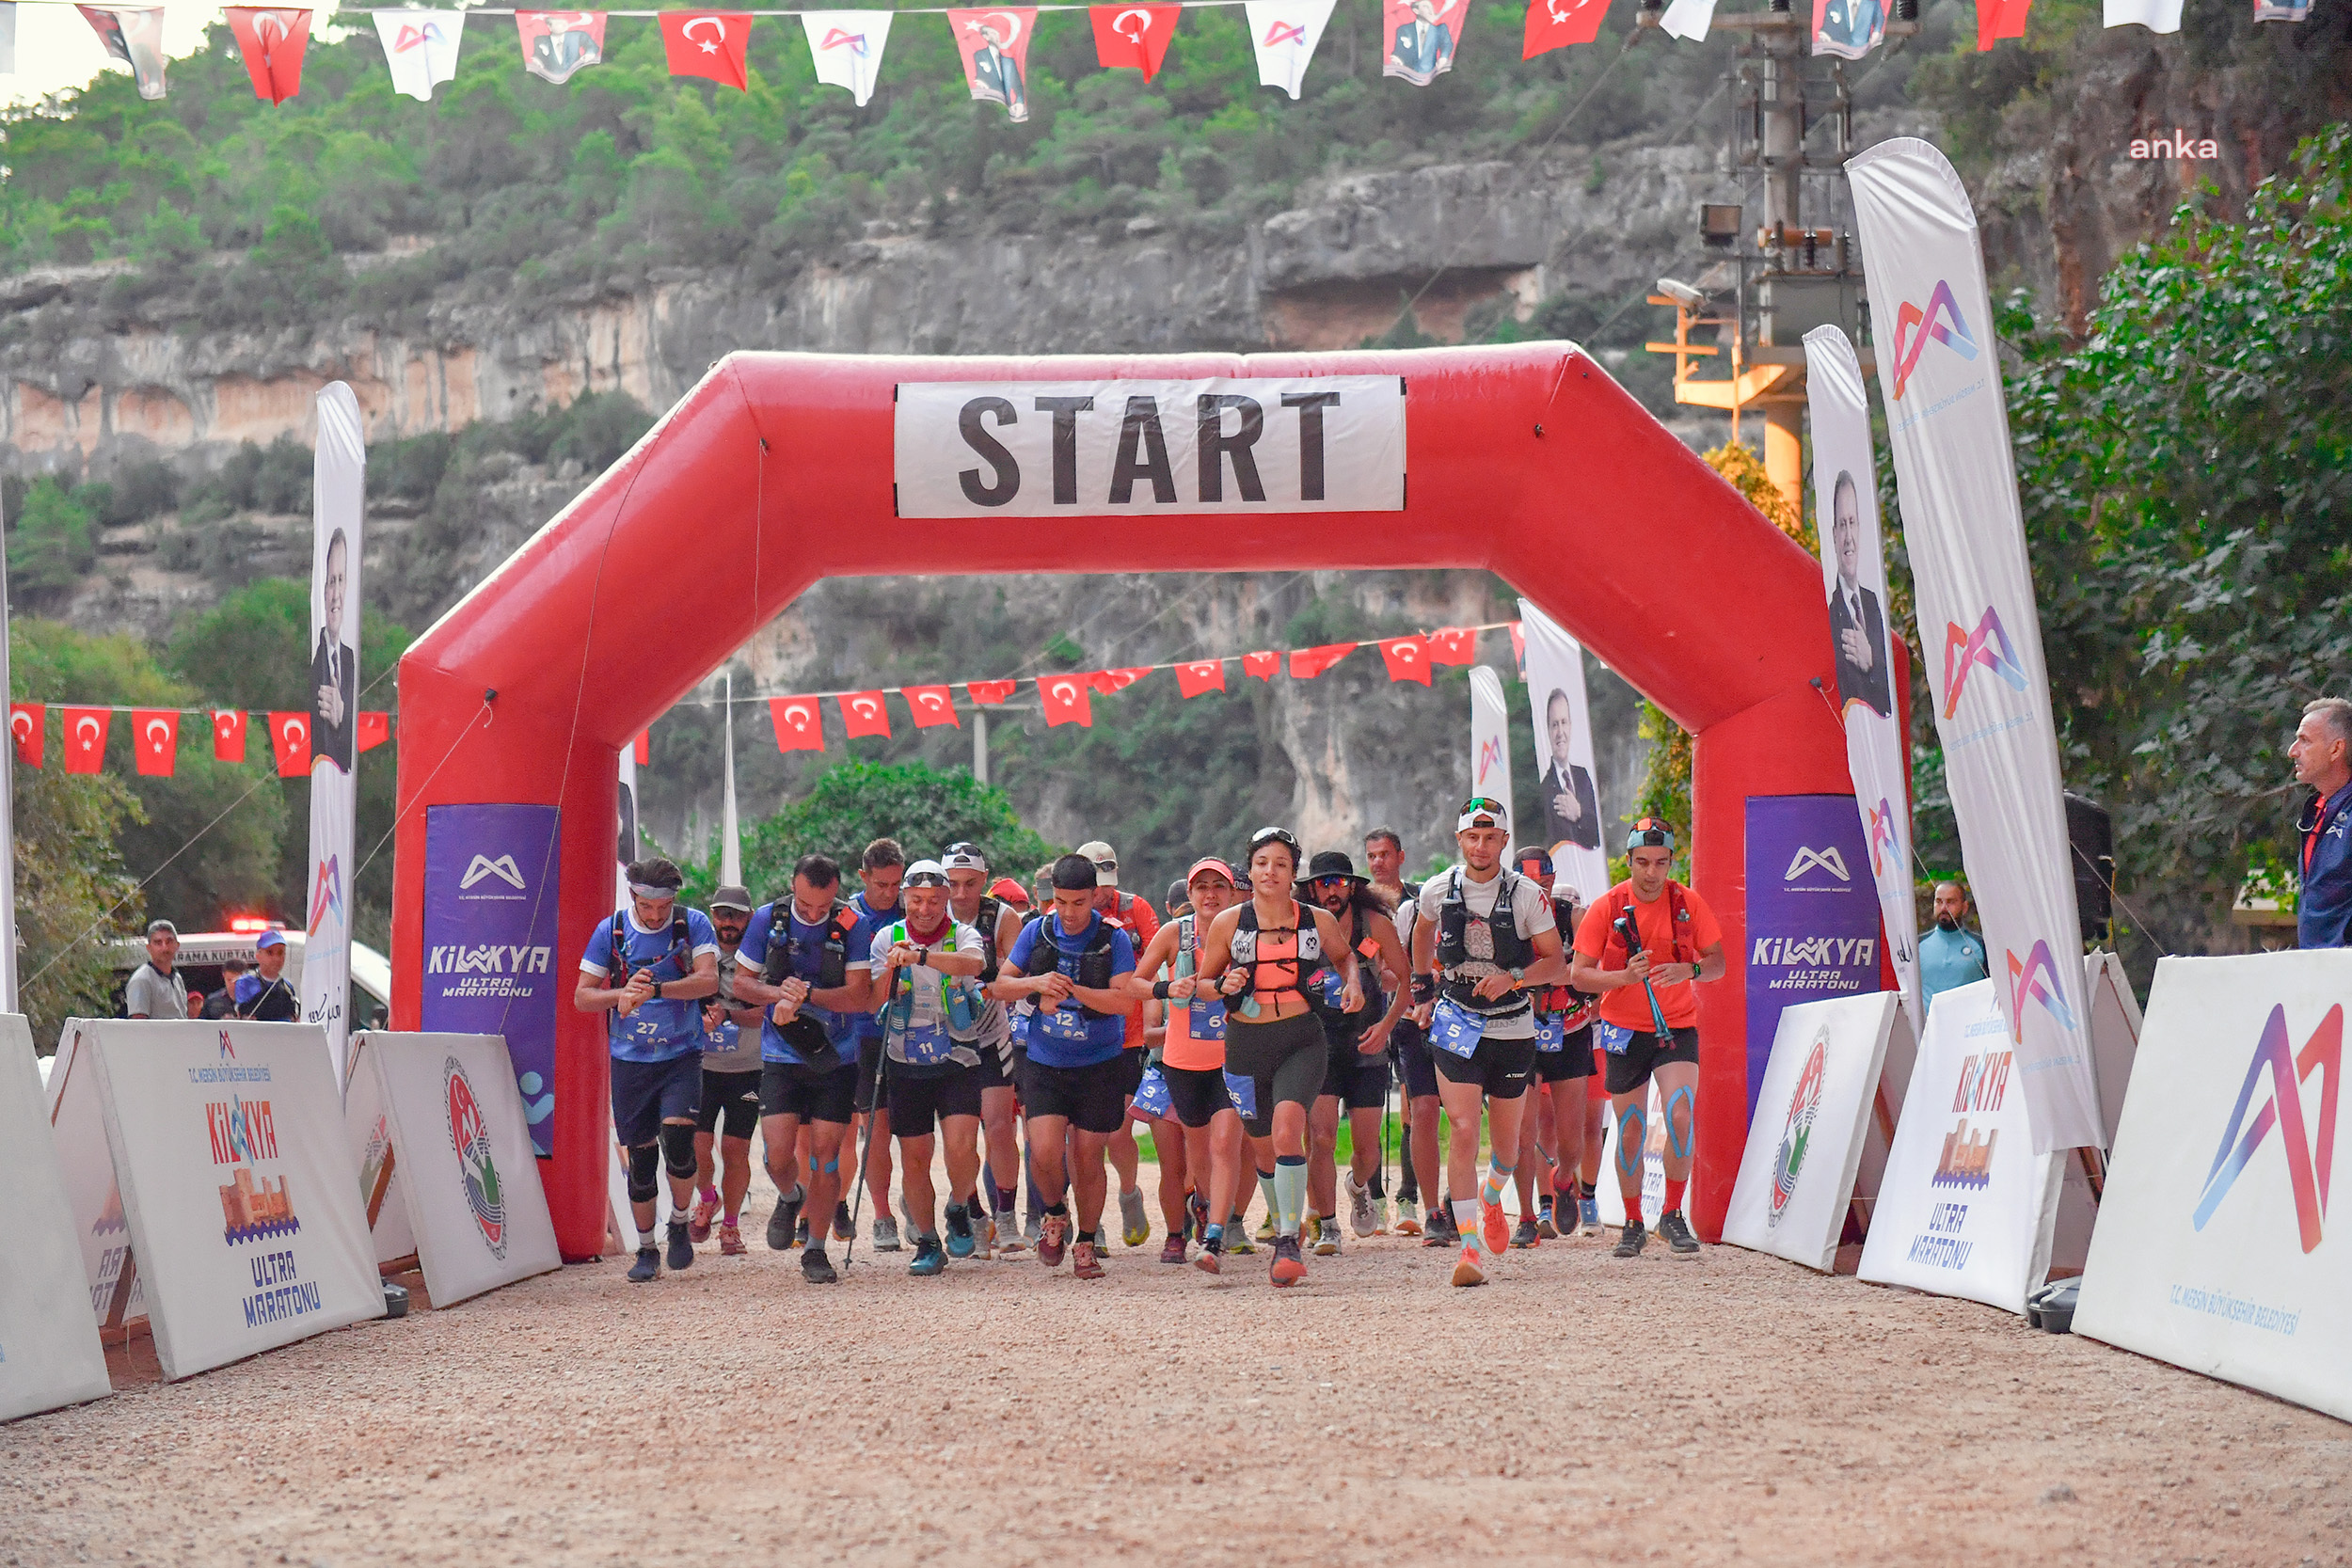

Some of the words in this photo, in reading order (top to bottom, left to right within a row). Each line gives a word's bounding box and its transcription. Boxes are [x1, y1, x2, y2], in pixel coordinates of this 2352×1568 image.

[958, 391, 1341, 507] START
[174, 951, 209, 962] RAMA
[1788, 970, 1841, 980] ULTRA
[460, 977, 513, 988] ULTRA
[1769, 979, 1860, 990] MARATONU
[442, 988, 532, 997] MARATONU
[1055, 1013, 1073, 1027] 12
[636, 1022, 659, 1035] 27
[1446, 1023, 1462, 1038] 5
[1534, 1029, 1552, 1040] 20
[1603, 1024, 1618, 1040] 14
[708, 1031, 724, 1043] 13
[918, 1041, 934, 1054] 11
[1142, 1085, 1156, 1099] 3
[1641, 1172, 1663, 1193] LTRA
[1929, 1202, 1968, 1234] ULTRA
[1906, 1234, 1974, 1271] MARATONU
[250, 1250, 297, 1288] ULTRA
[242, 1281, 322, 1328] MARATONU
[2182, 1285, 2209, 1313] MERSİN
[2254, 1304, 2302, 1338] BELEDİYESİ
